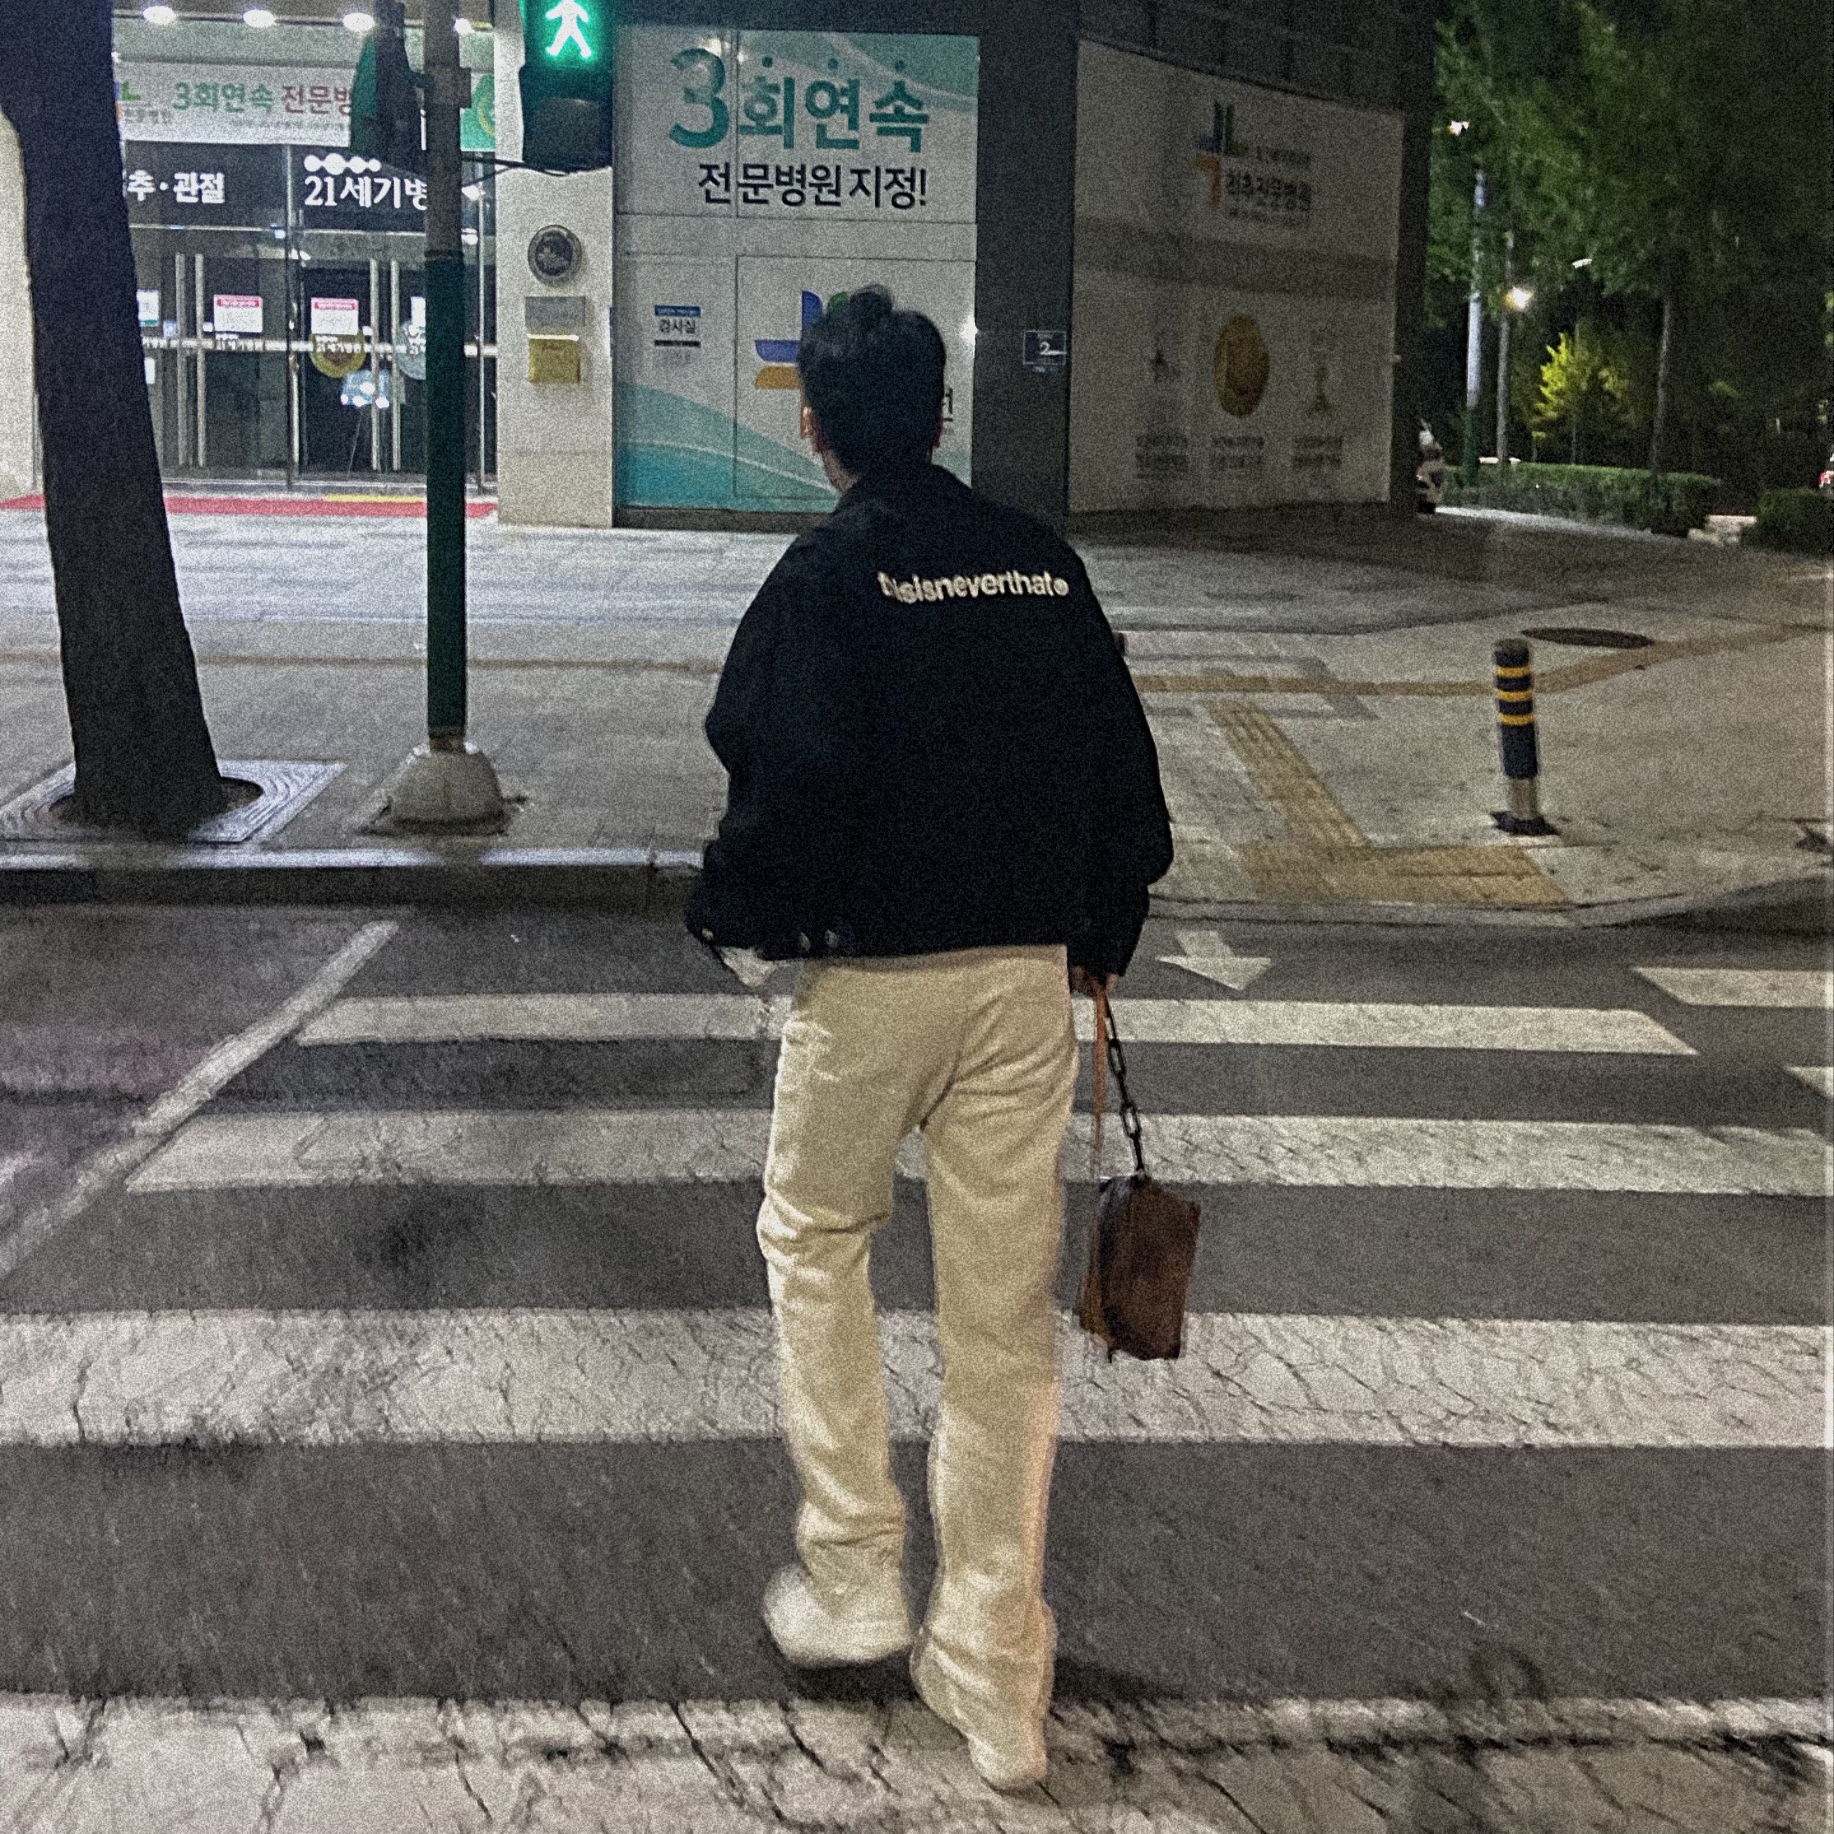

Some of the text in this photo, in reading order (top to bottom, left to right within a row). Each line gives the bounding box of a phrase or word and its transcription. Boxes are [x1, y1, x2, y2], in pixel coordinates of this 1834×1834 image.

[173, 81, 274, 114] 3회연속
[668, 47, 930, 154] 3회연속
[122, 169, 226, 204] 추·관절
